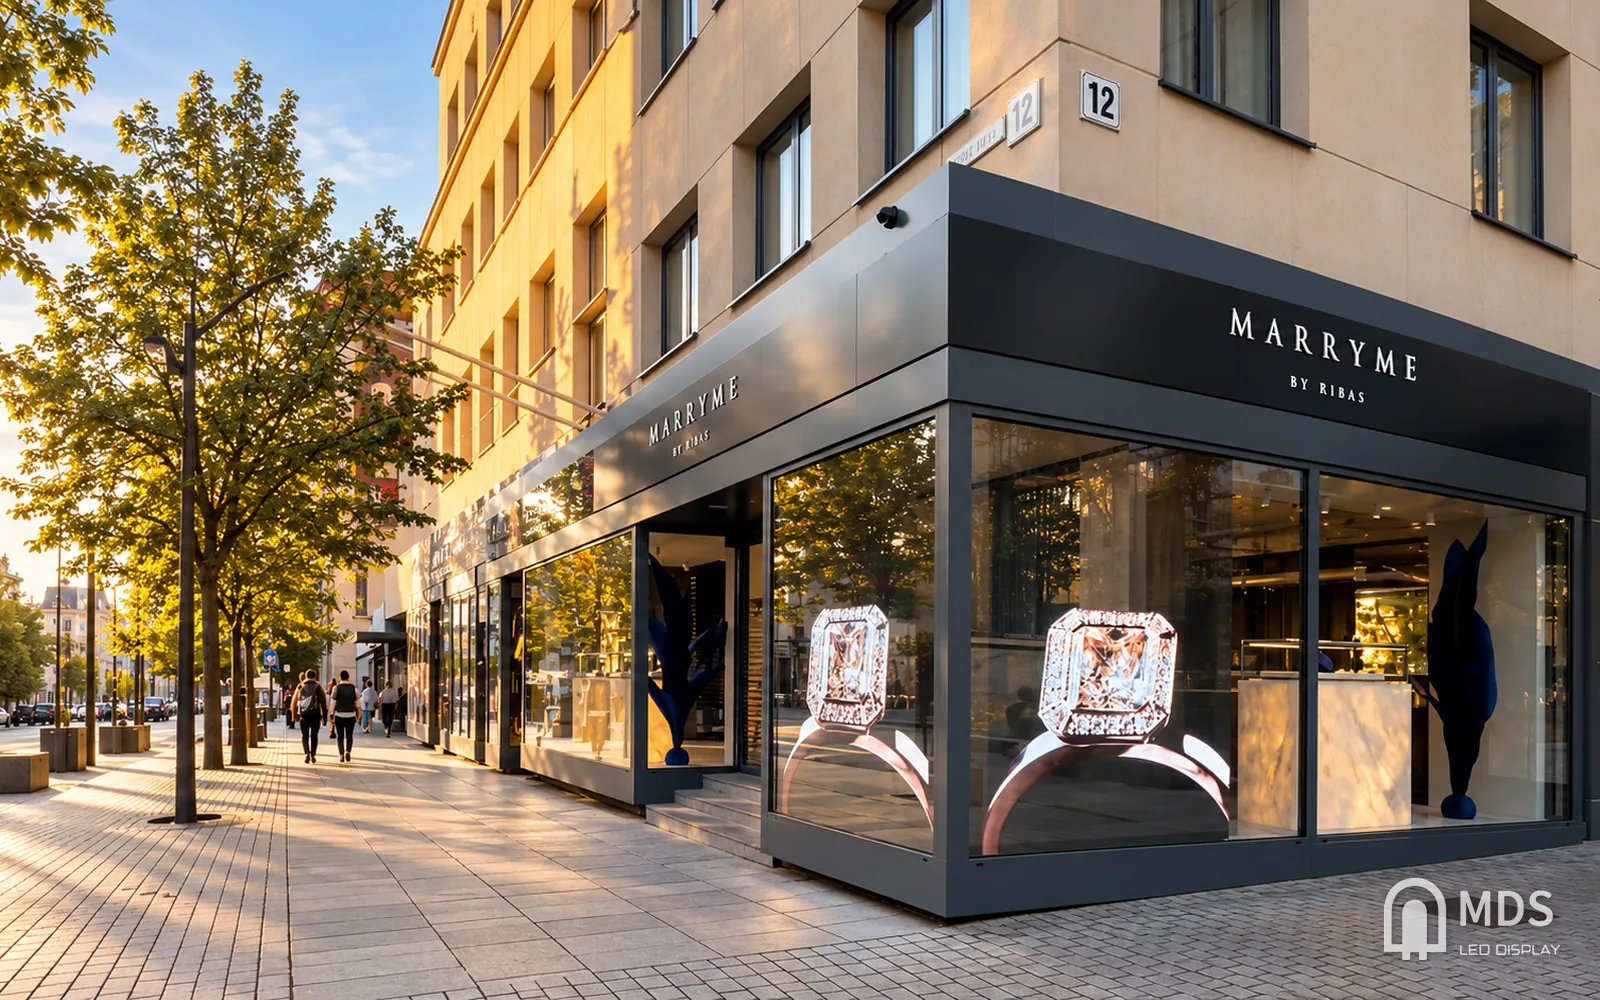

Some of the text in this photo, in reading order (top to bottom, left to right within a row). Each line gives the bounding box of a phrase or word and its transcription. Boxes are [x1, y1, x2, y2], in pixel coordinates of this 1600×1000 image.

[1012, 91, 1034, 133] 12
[1088, 81, 1115, 121] 12
[1229, 307, 1418, 382] MARRYME
[1290, 375, 1365, 404] BY RIBAS
[649, 375, 739, 447] MARRYME
[672, 429, 710, 457] BY RIBAS
